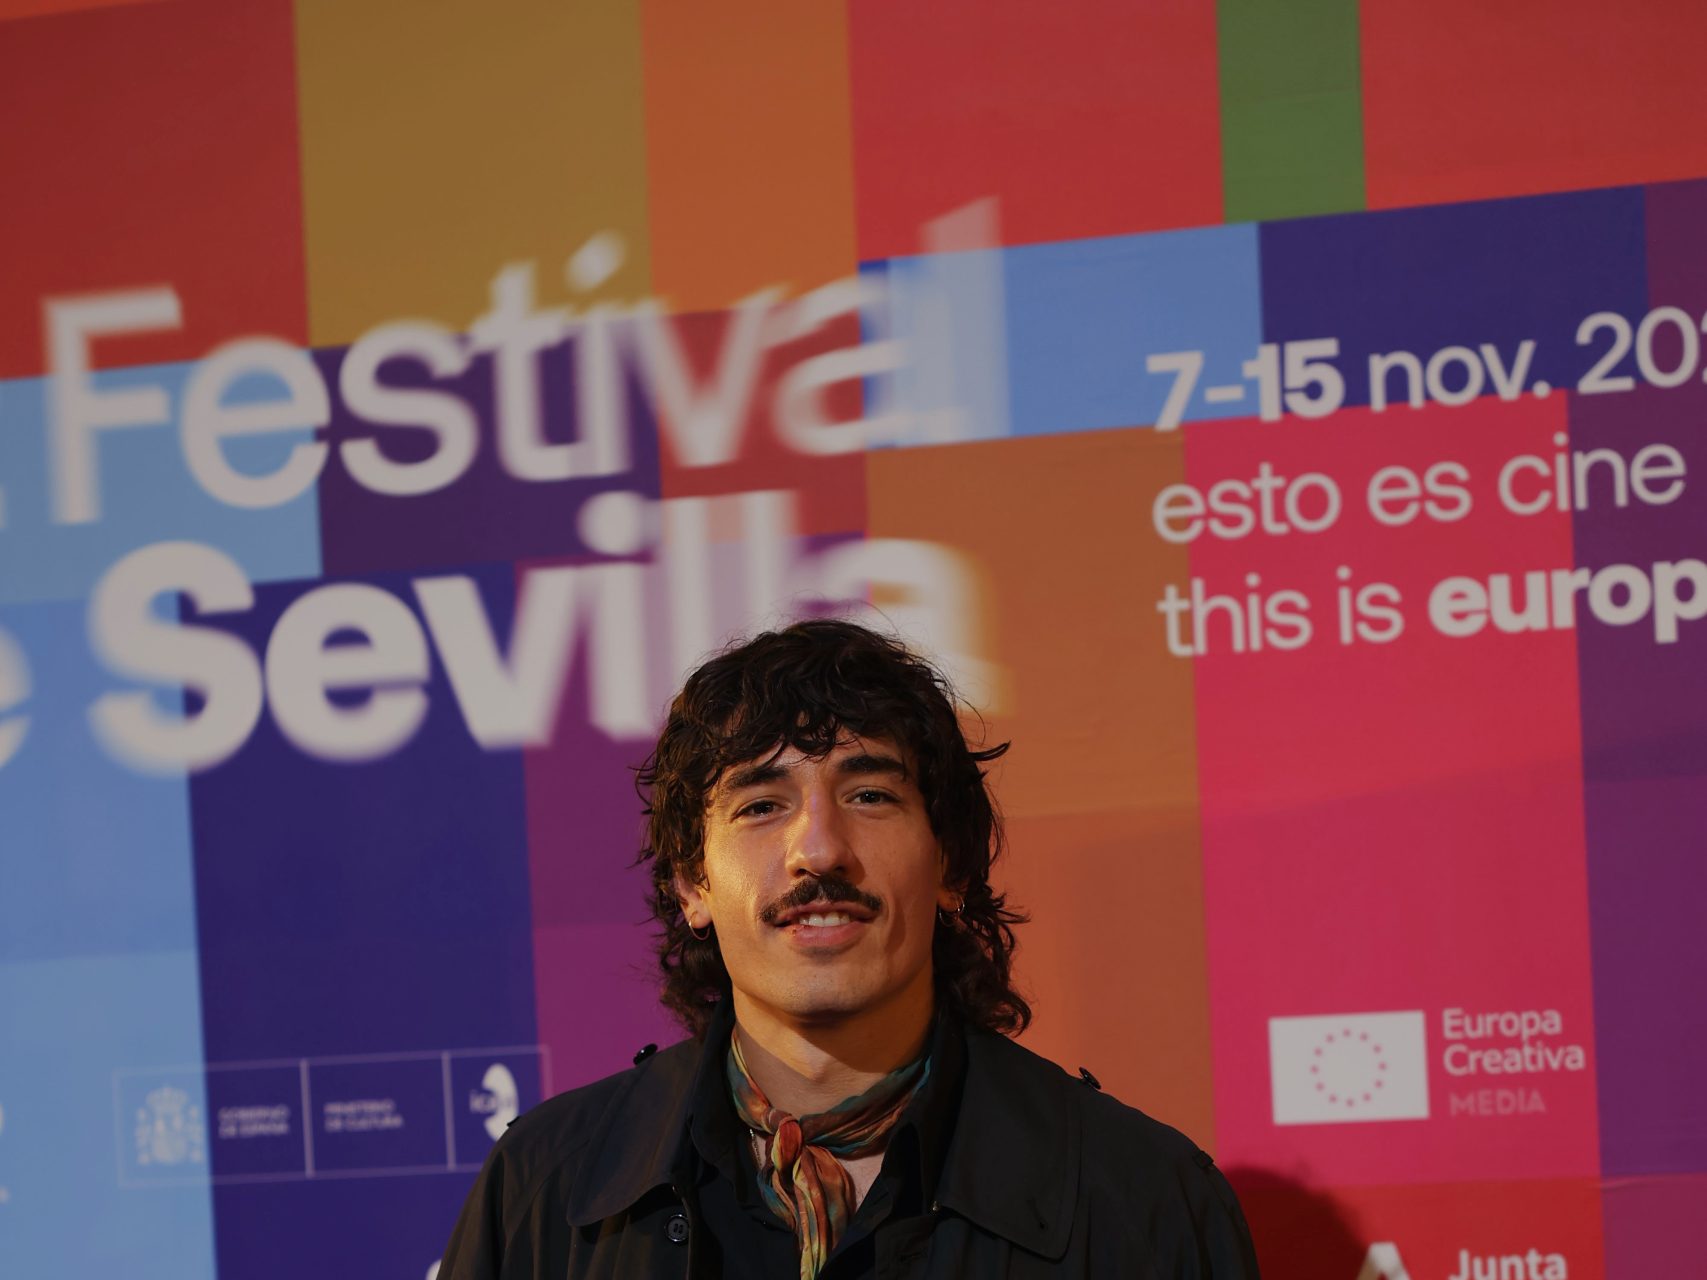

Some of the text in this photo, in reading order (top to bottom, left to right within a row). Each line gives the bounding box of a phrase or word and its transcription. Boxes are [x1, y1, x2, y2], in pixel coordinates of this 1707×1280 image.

[42, 197, 1012, 525] Festival
[1146, 305, 1707, 432] 7-15 nov. 20
[1153, 431, 1687, 543] esto es cine
[1156, 572, 1313, 657] this
[1336, 565, 1405, 645] is
[1442, 1007, 1562, 1044] Europa
[1443, 1040, 1586, 1076] Creativa
[1449, 1087, 1547, 1117] MEDIA
